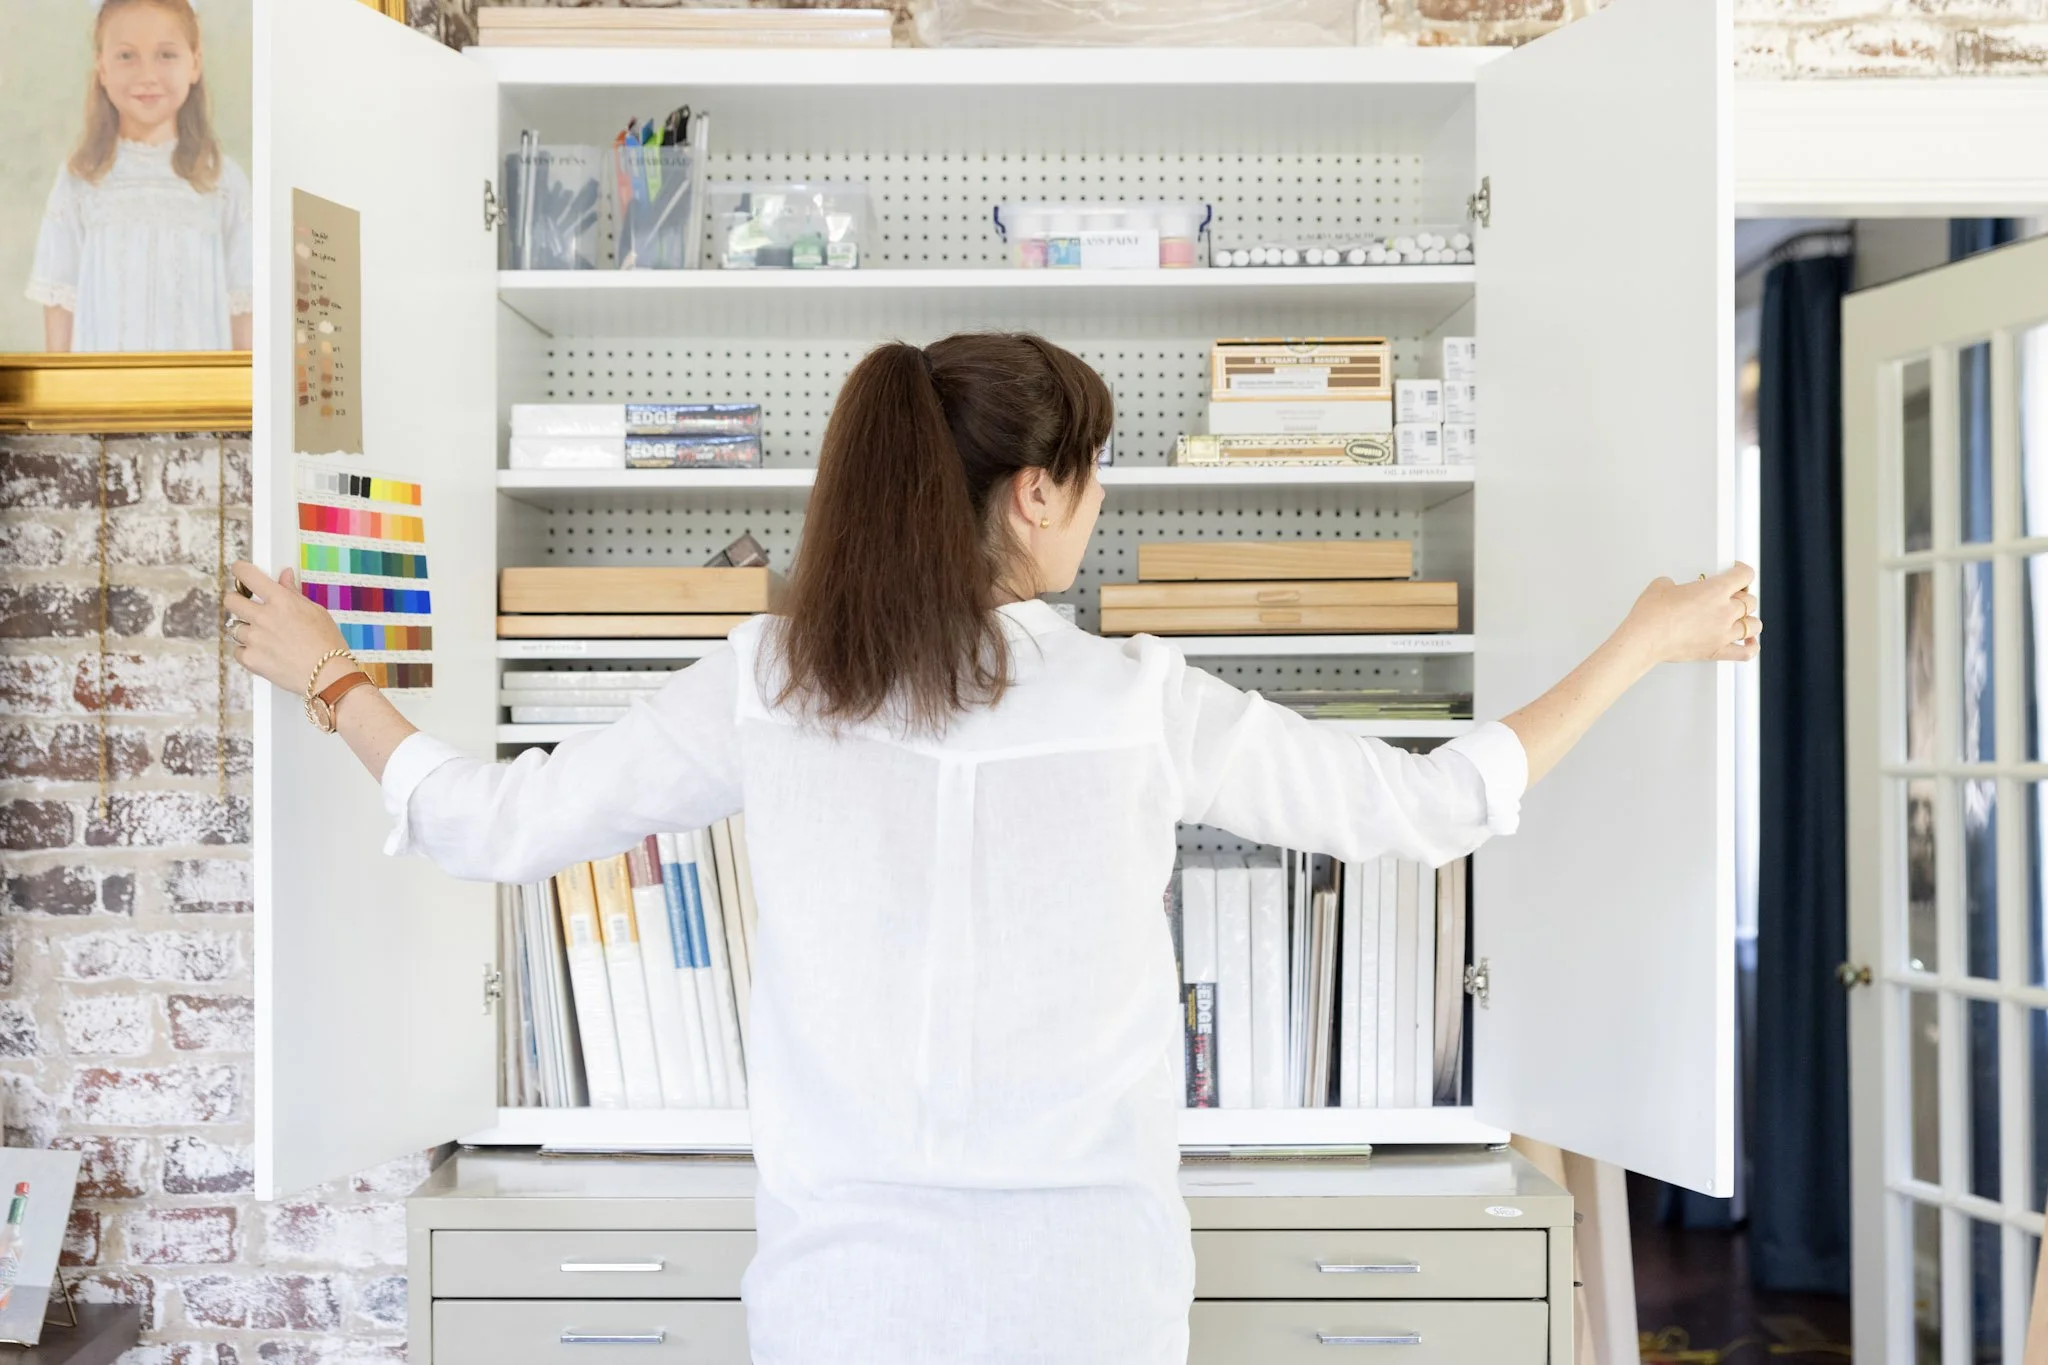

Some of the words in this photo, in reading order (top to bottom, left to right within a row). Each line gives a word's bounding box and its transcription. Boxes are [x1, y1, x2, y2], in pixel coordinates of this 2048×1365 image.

[631, 410, 678, 425] EDGE
[630, 443, 678, 459] EDGE
[1196, 986, 1213, 1034] EDGE
